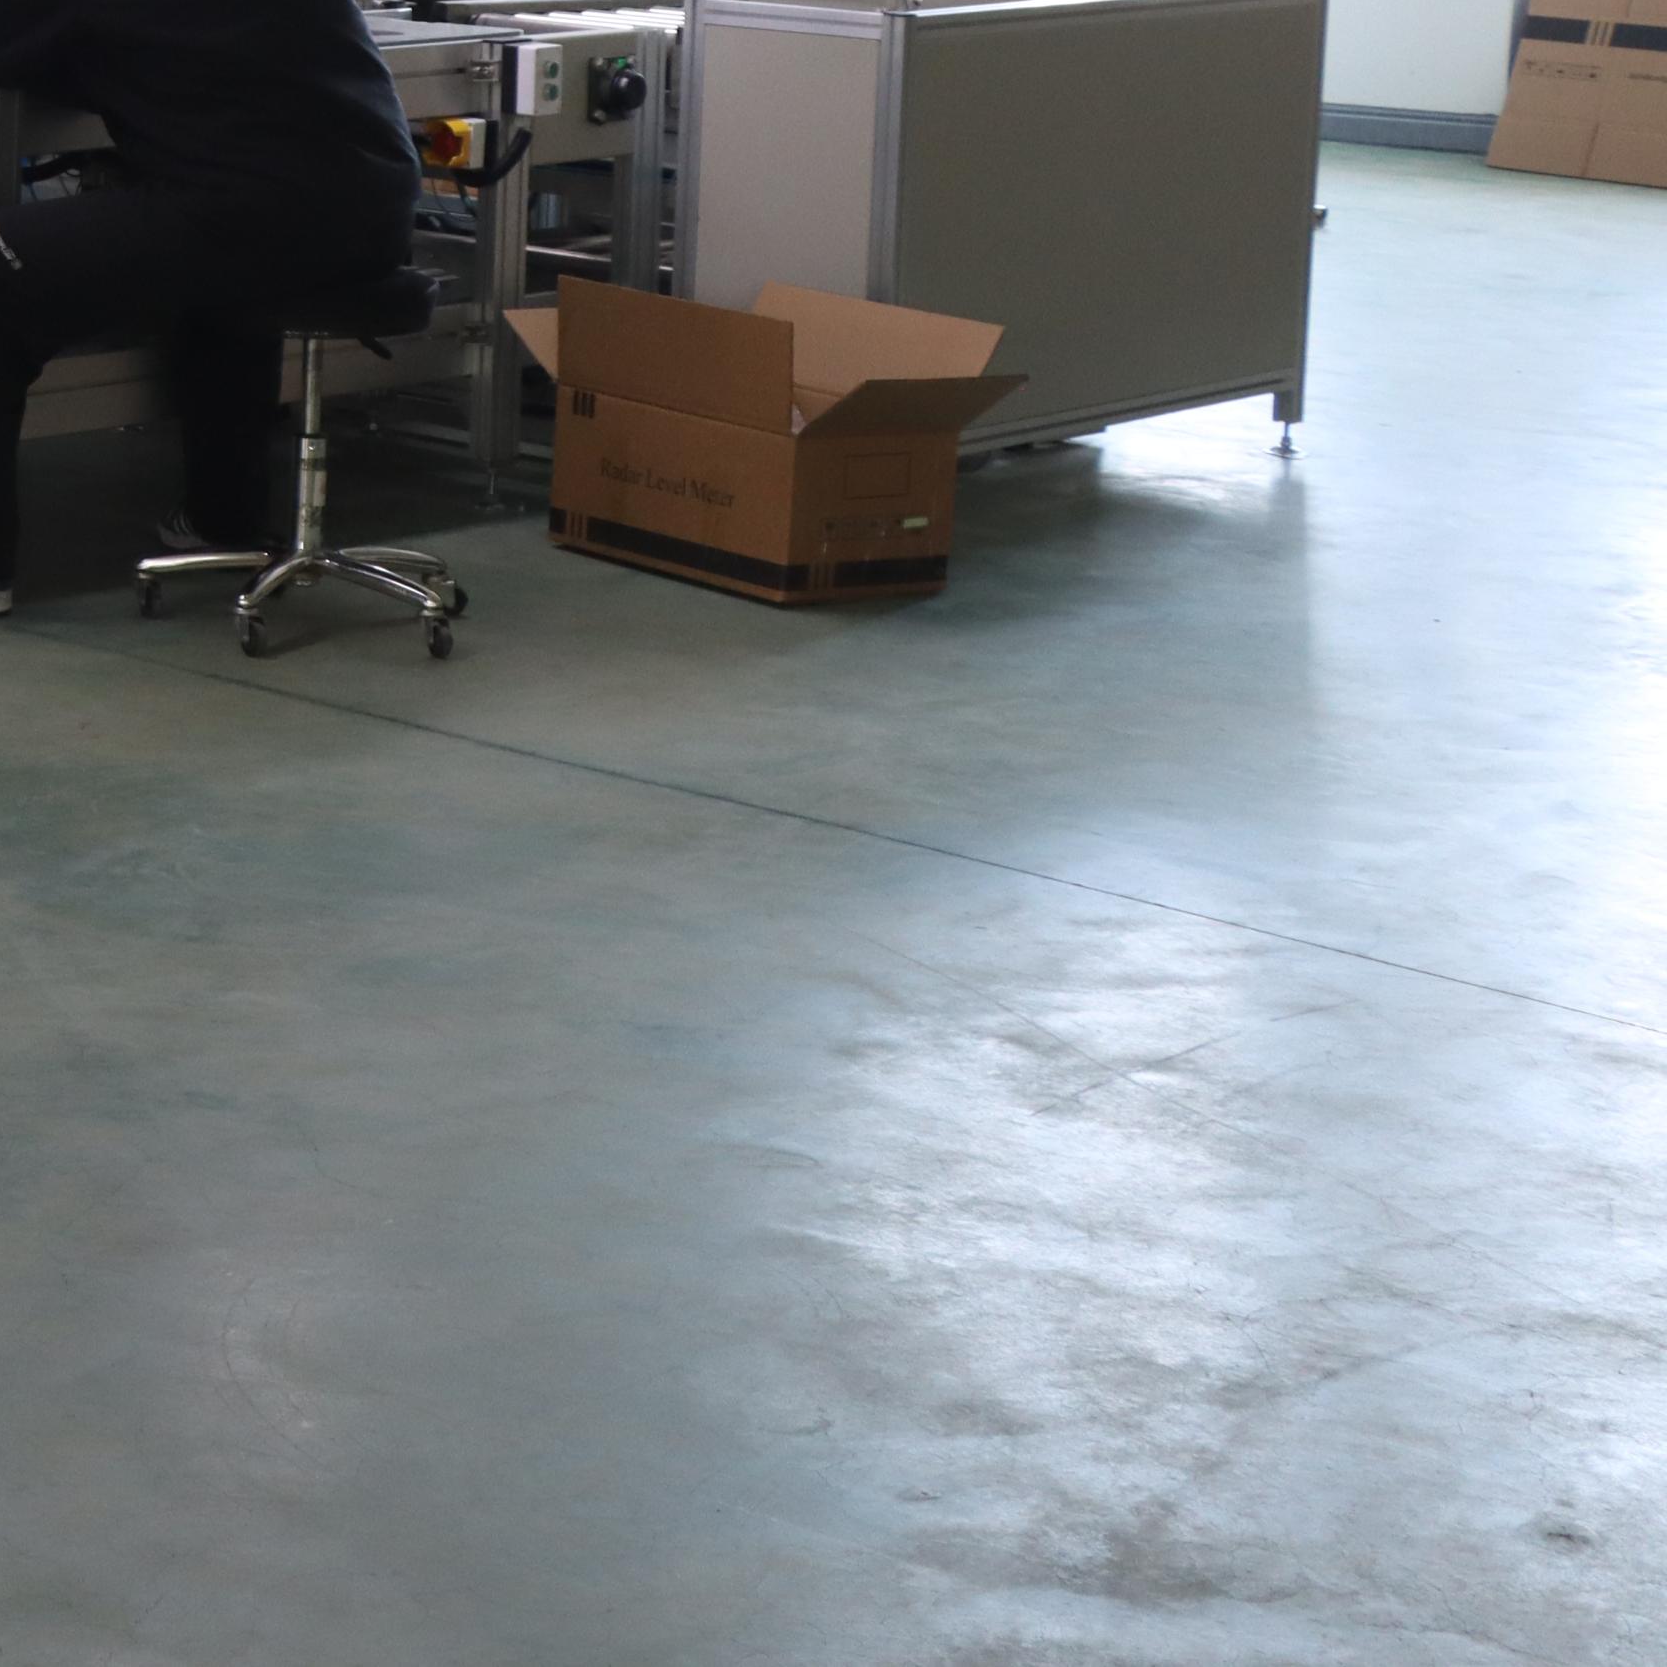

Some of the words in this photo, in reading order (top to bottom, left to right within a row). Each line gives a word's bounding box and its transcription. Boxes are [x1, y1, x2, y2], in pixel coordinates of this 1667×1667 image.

[600, 456, 643, 485] Radar
[646, 467, 687, 496] Level
[689, 478, 736, 509] Meter
